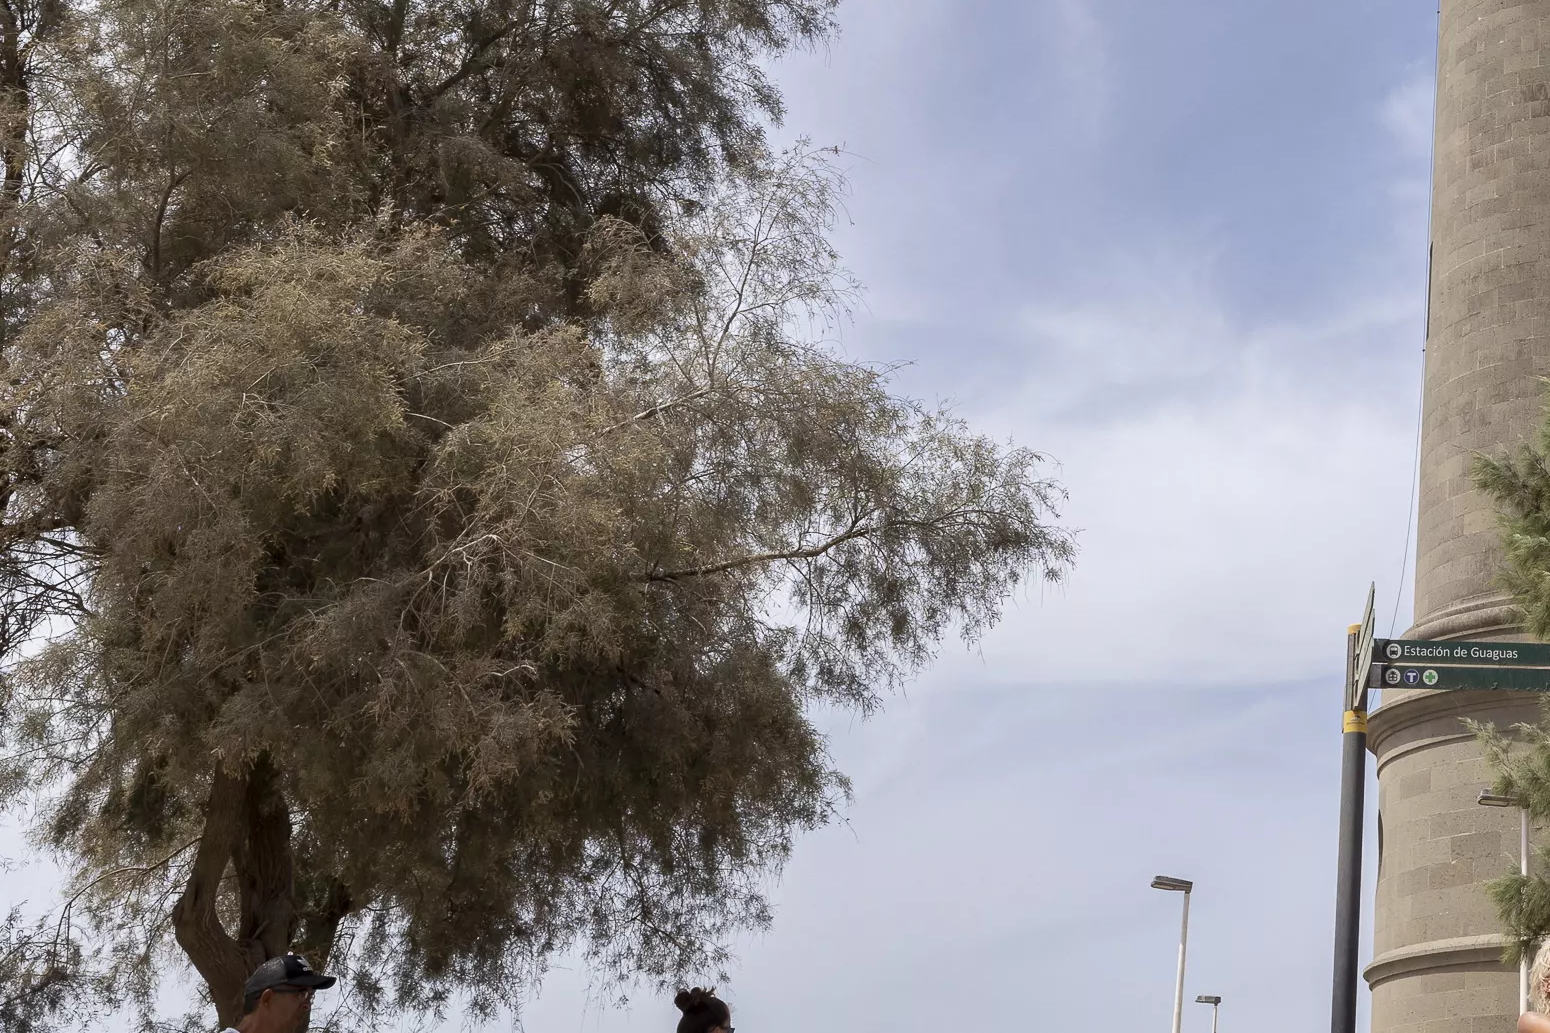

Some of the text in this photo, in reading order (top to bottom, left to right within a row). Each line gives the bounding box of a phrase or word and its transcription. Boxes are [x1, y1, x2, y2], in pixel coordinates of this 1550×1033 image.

[1404, 645, 1518, 661] Estación de Guaguas
